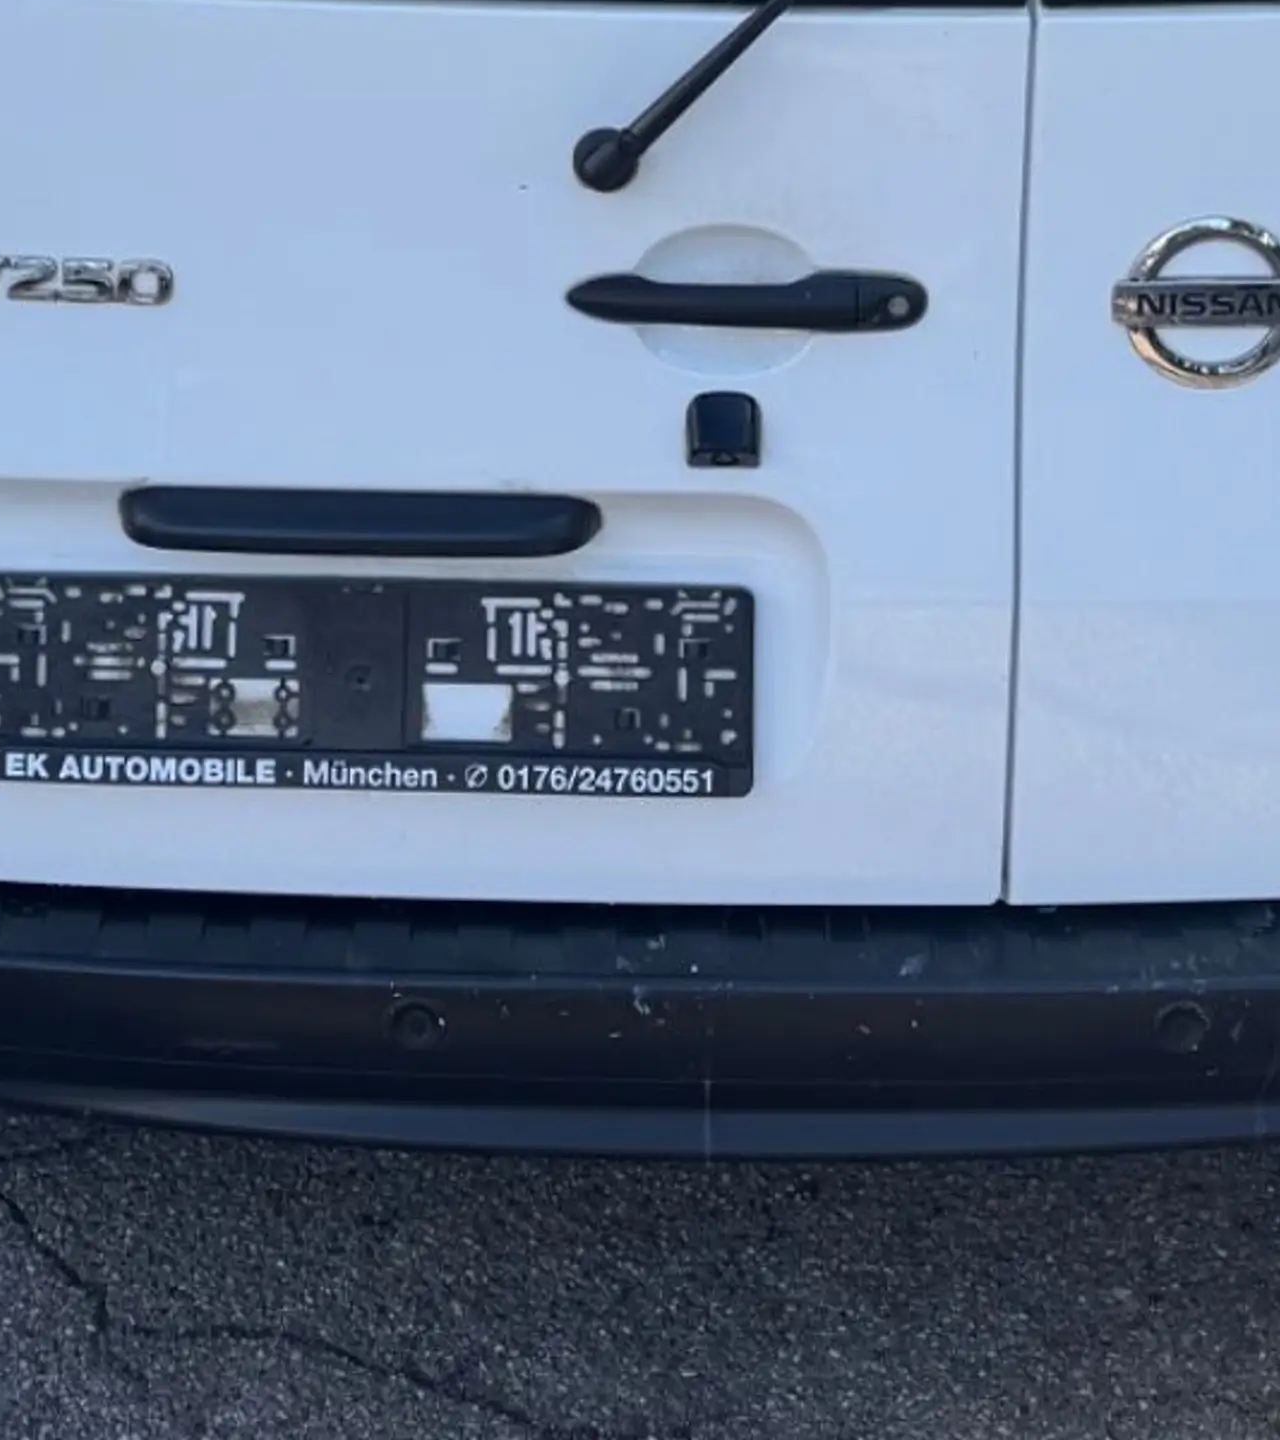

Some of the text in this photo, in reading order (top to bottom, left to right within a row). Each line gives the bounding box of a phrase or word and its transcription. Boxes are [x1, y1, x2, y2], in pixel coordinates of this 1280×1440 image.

[4, 752, 714, 794] EK AUTOMOBILE München 0176/24760551
